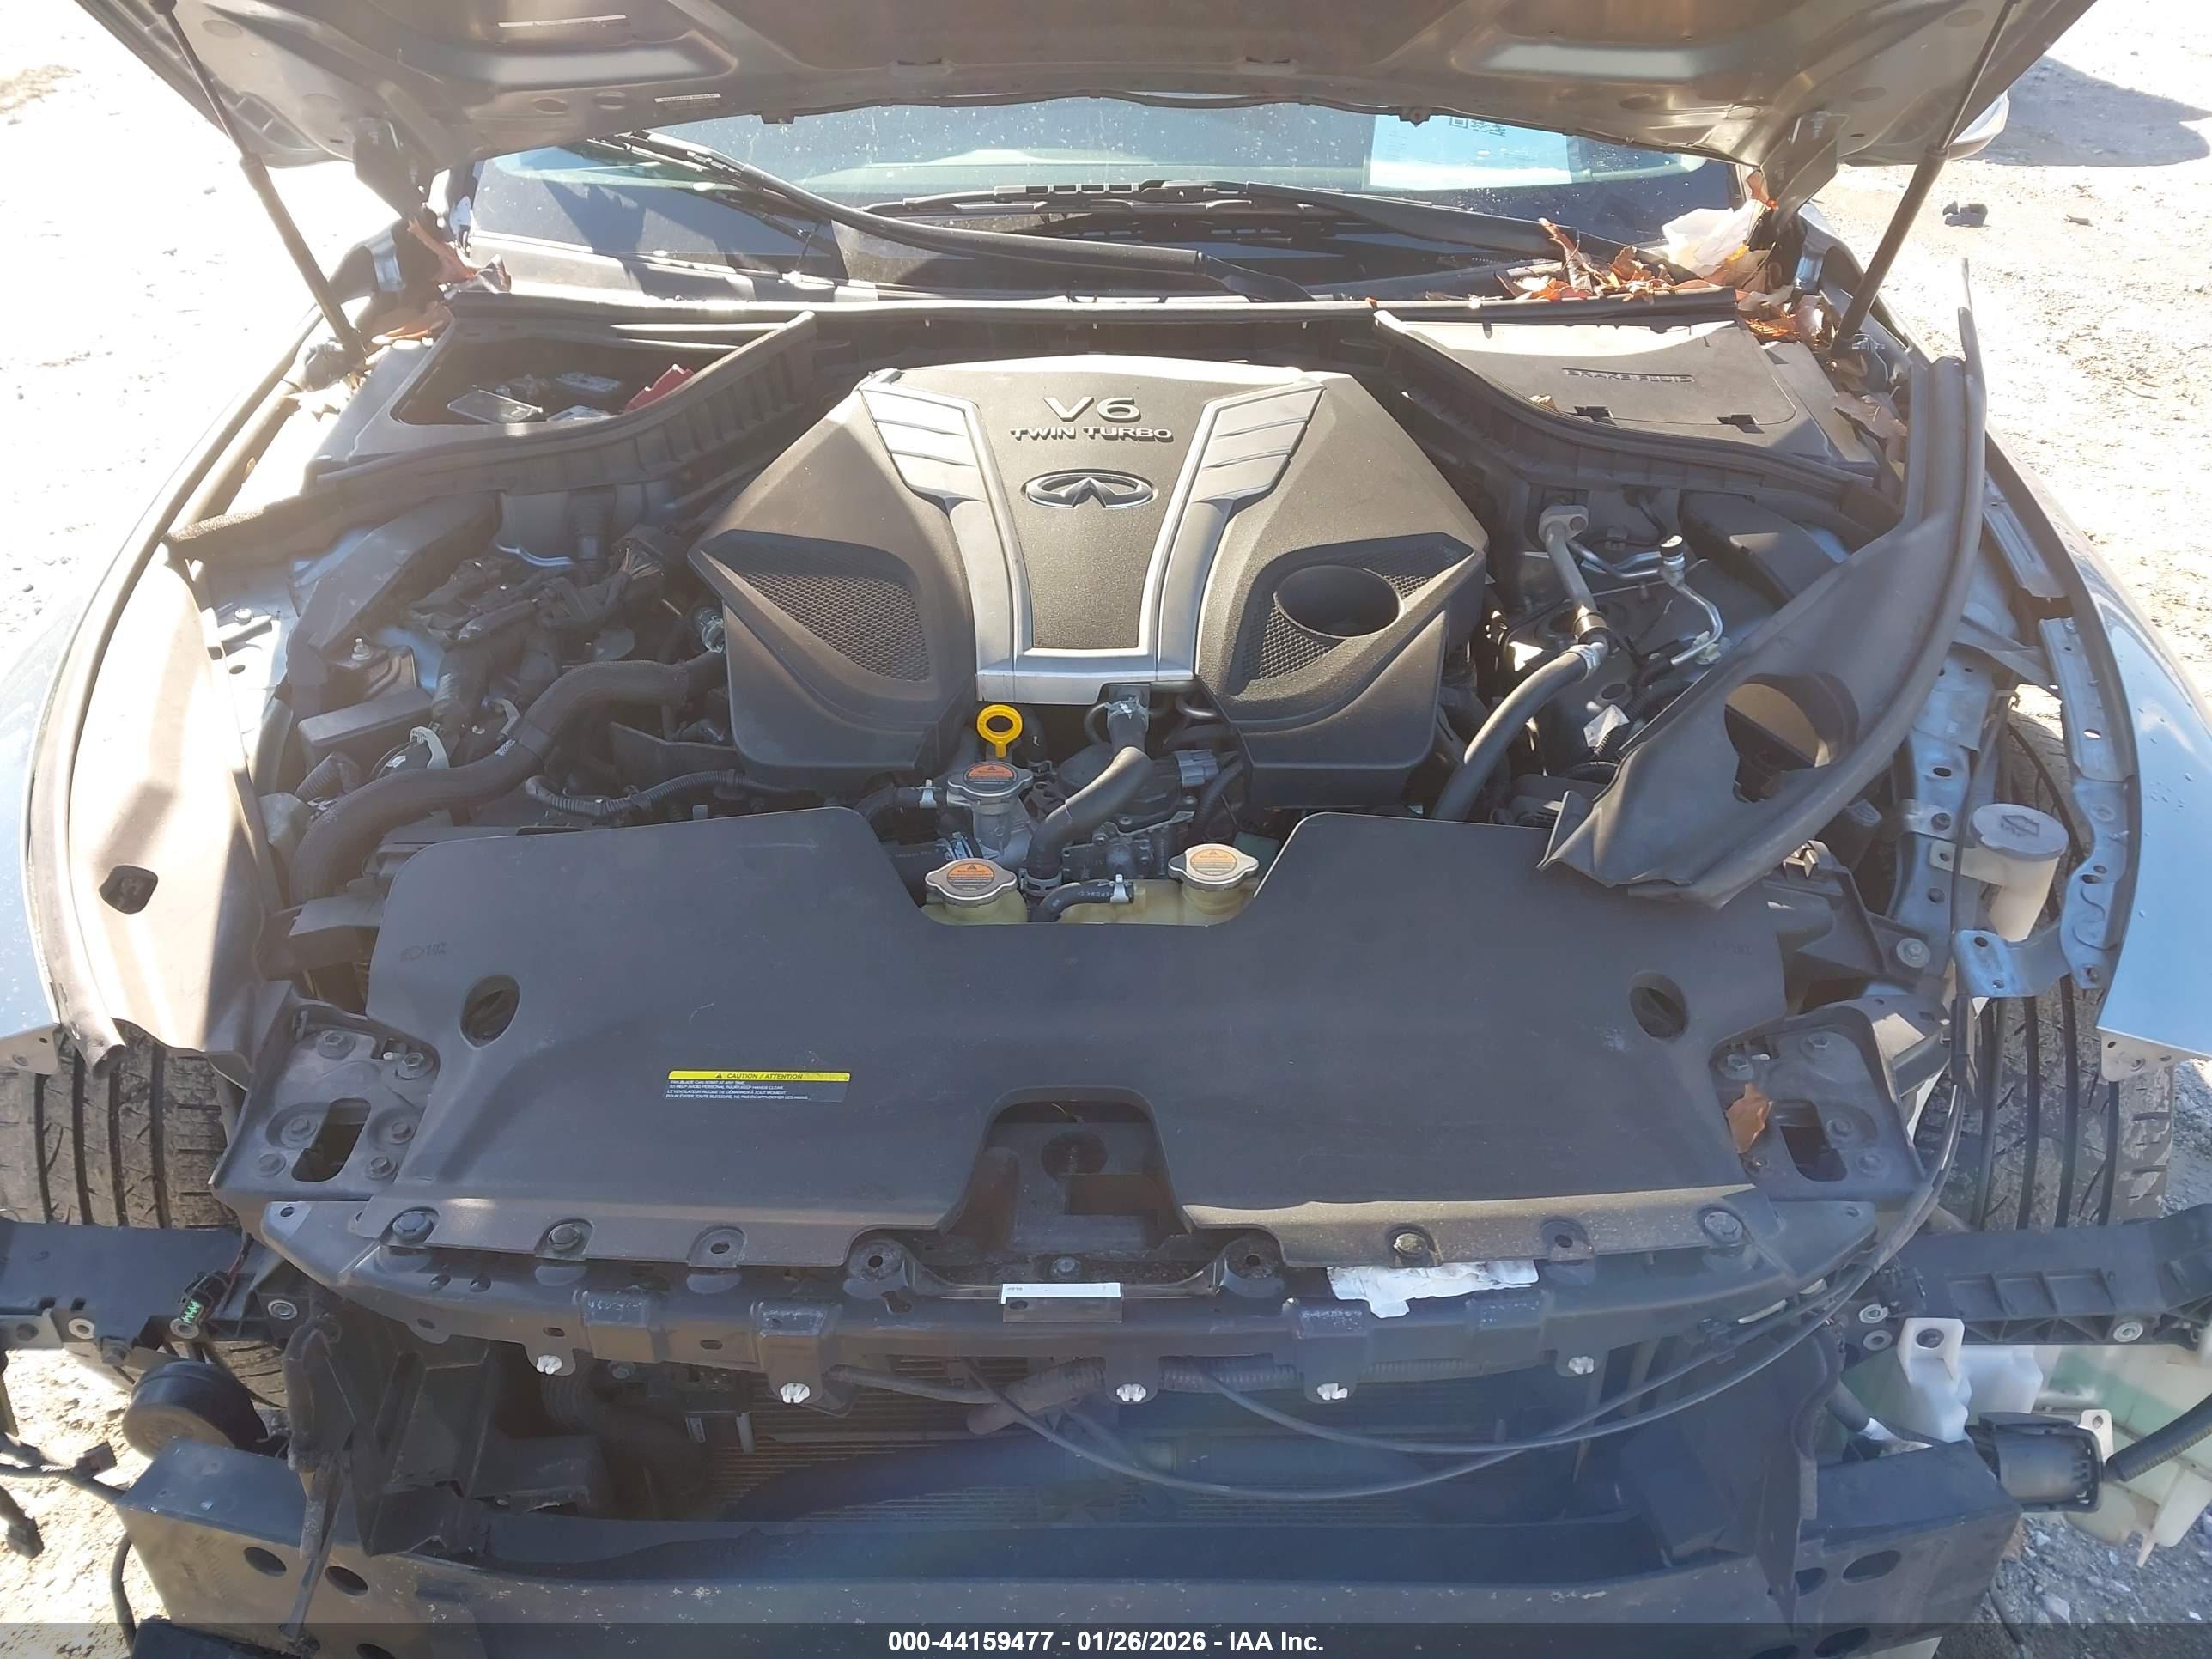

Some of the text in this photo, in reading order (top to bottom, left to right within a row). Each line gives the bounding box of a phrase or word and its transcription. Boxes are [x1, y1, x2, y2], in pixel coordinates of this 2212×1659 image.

[1043, 397, 1142, 423] V6
[1010, 427, 1174, 443] TWIN TURBO
